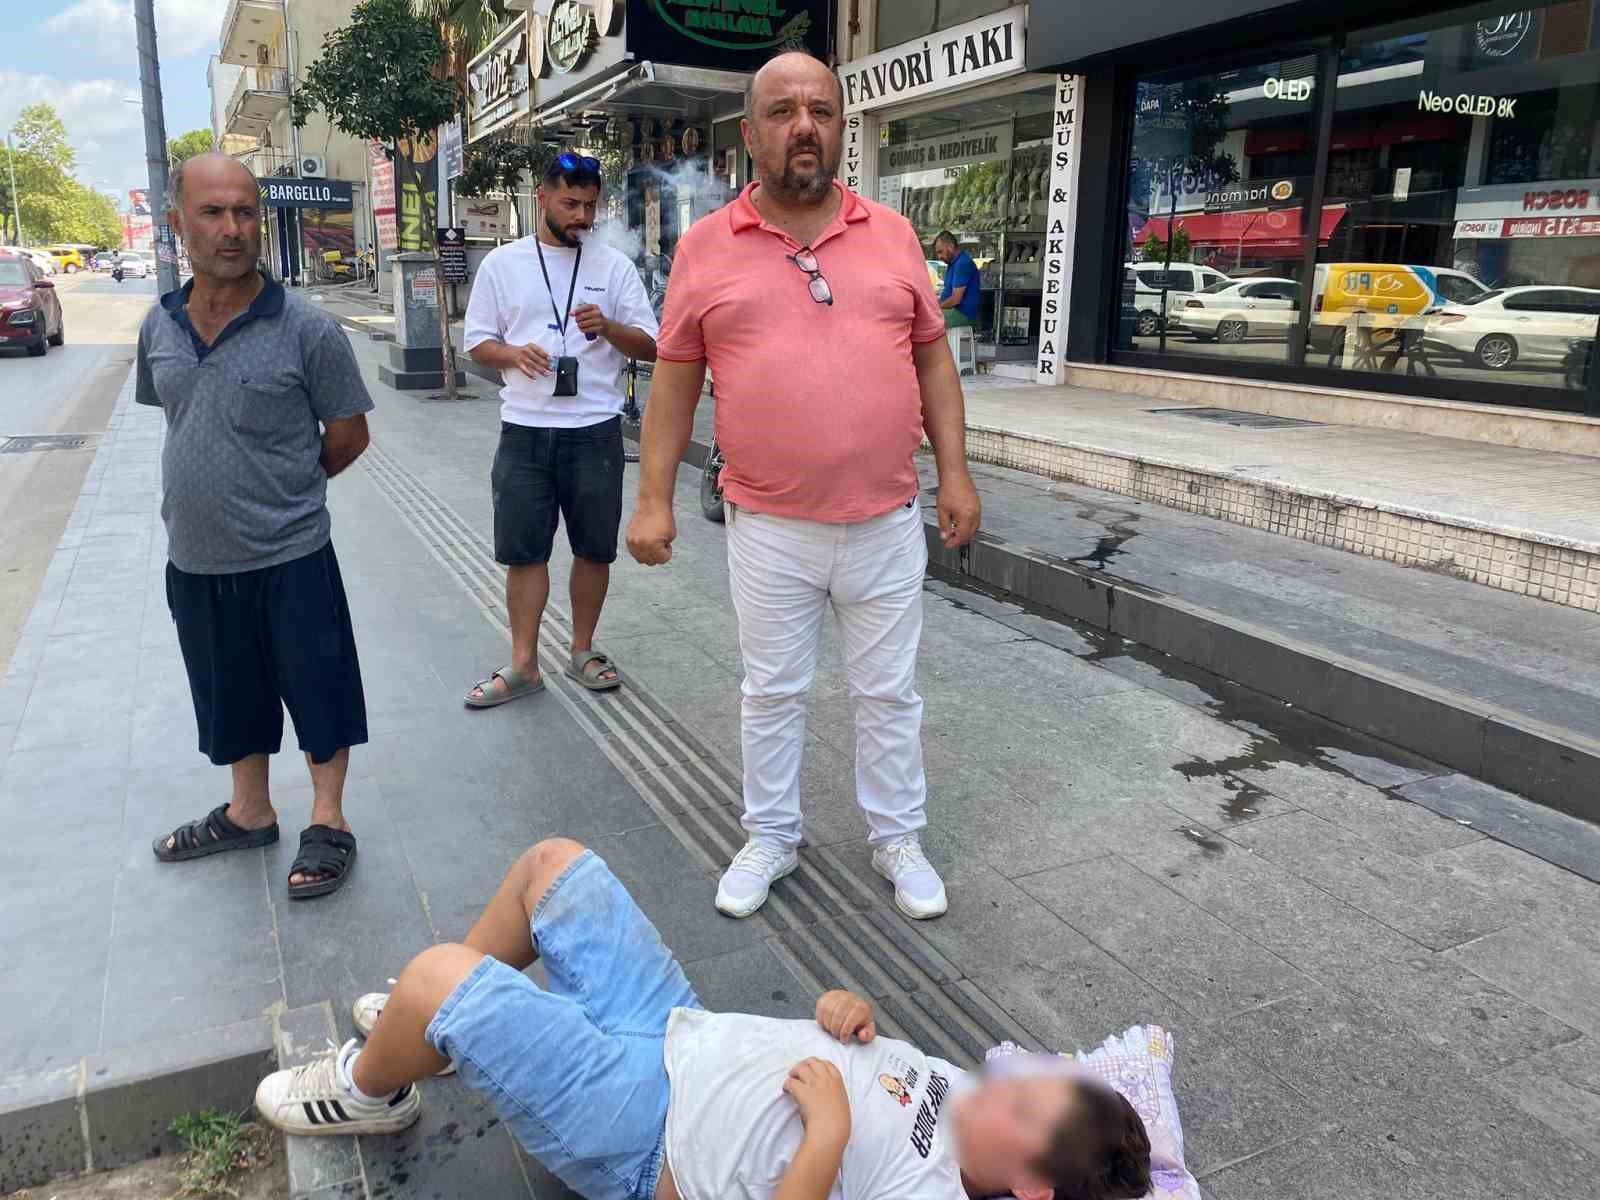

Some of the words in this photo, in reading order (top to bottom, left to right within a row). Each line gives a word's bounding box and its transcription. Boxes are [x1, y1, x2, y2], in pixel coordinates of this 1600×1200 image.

[845, 41, 934, 105] FAVORİ
[942, 22, 1013, 77] TAKI
[1264, 77, 1311, 101] OLED
[1418, 90, 1453, 112] Neo
[1455, 94, 1496, 116] QLED
[1497, 97, 1517, 118] 8K
[847, 117, 860, 194] SILVE
[889, 144, 926, 168] GÜMÜŞ
[928, 148, 937, 162] &
[939, 132, 998, 161] HEDİYELİK
[269, 184, 331, 201] BARGELLO
[1053, 188, 1067, 203] &
[1040, 219, 1064, 375] AKSESUAR
[910, 1099, 936, 1159] RIDER
